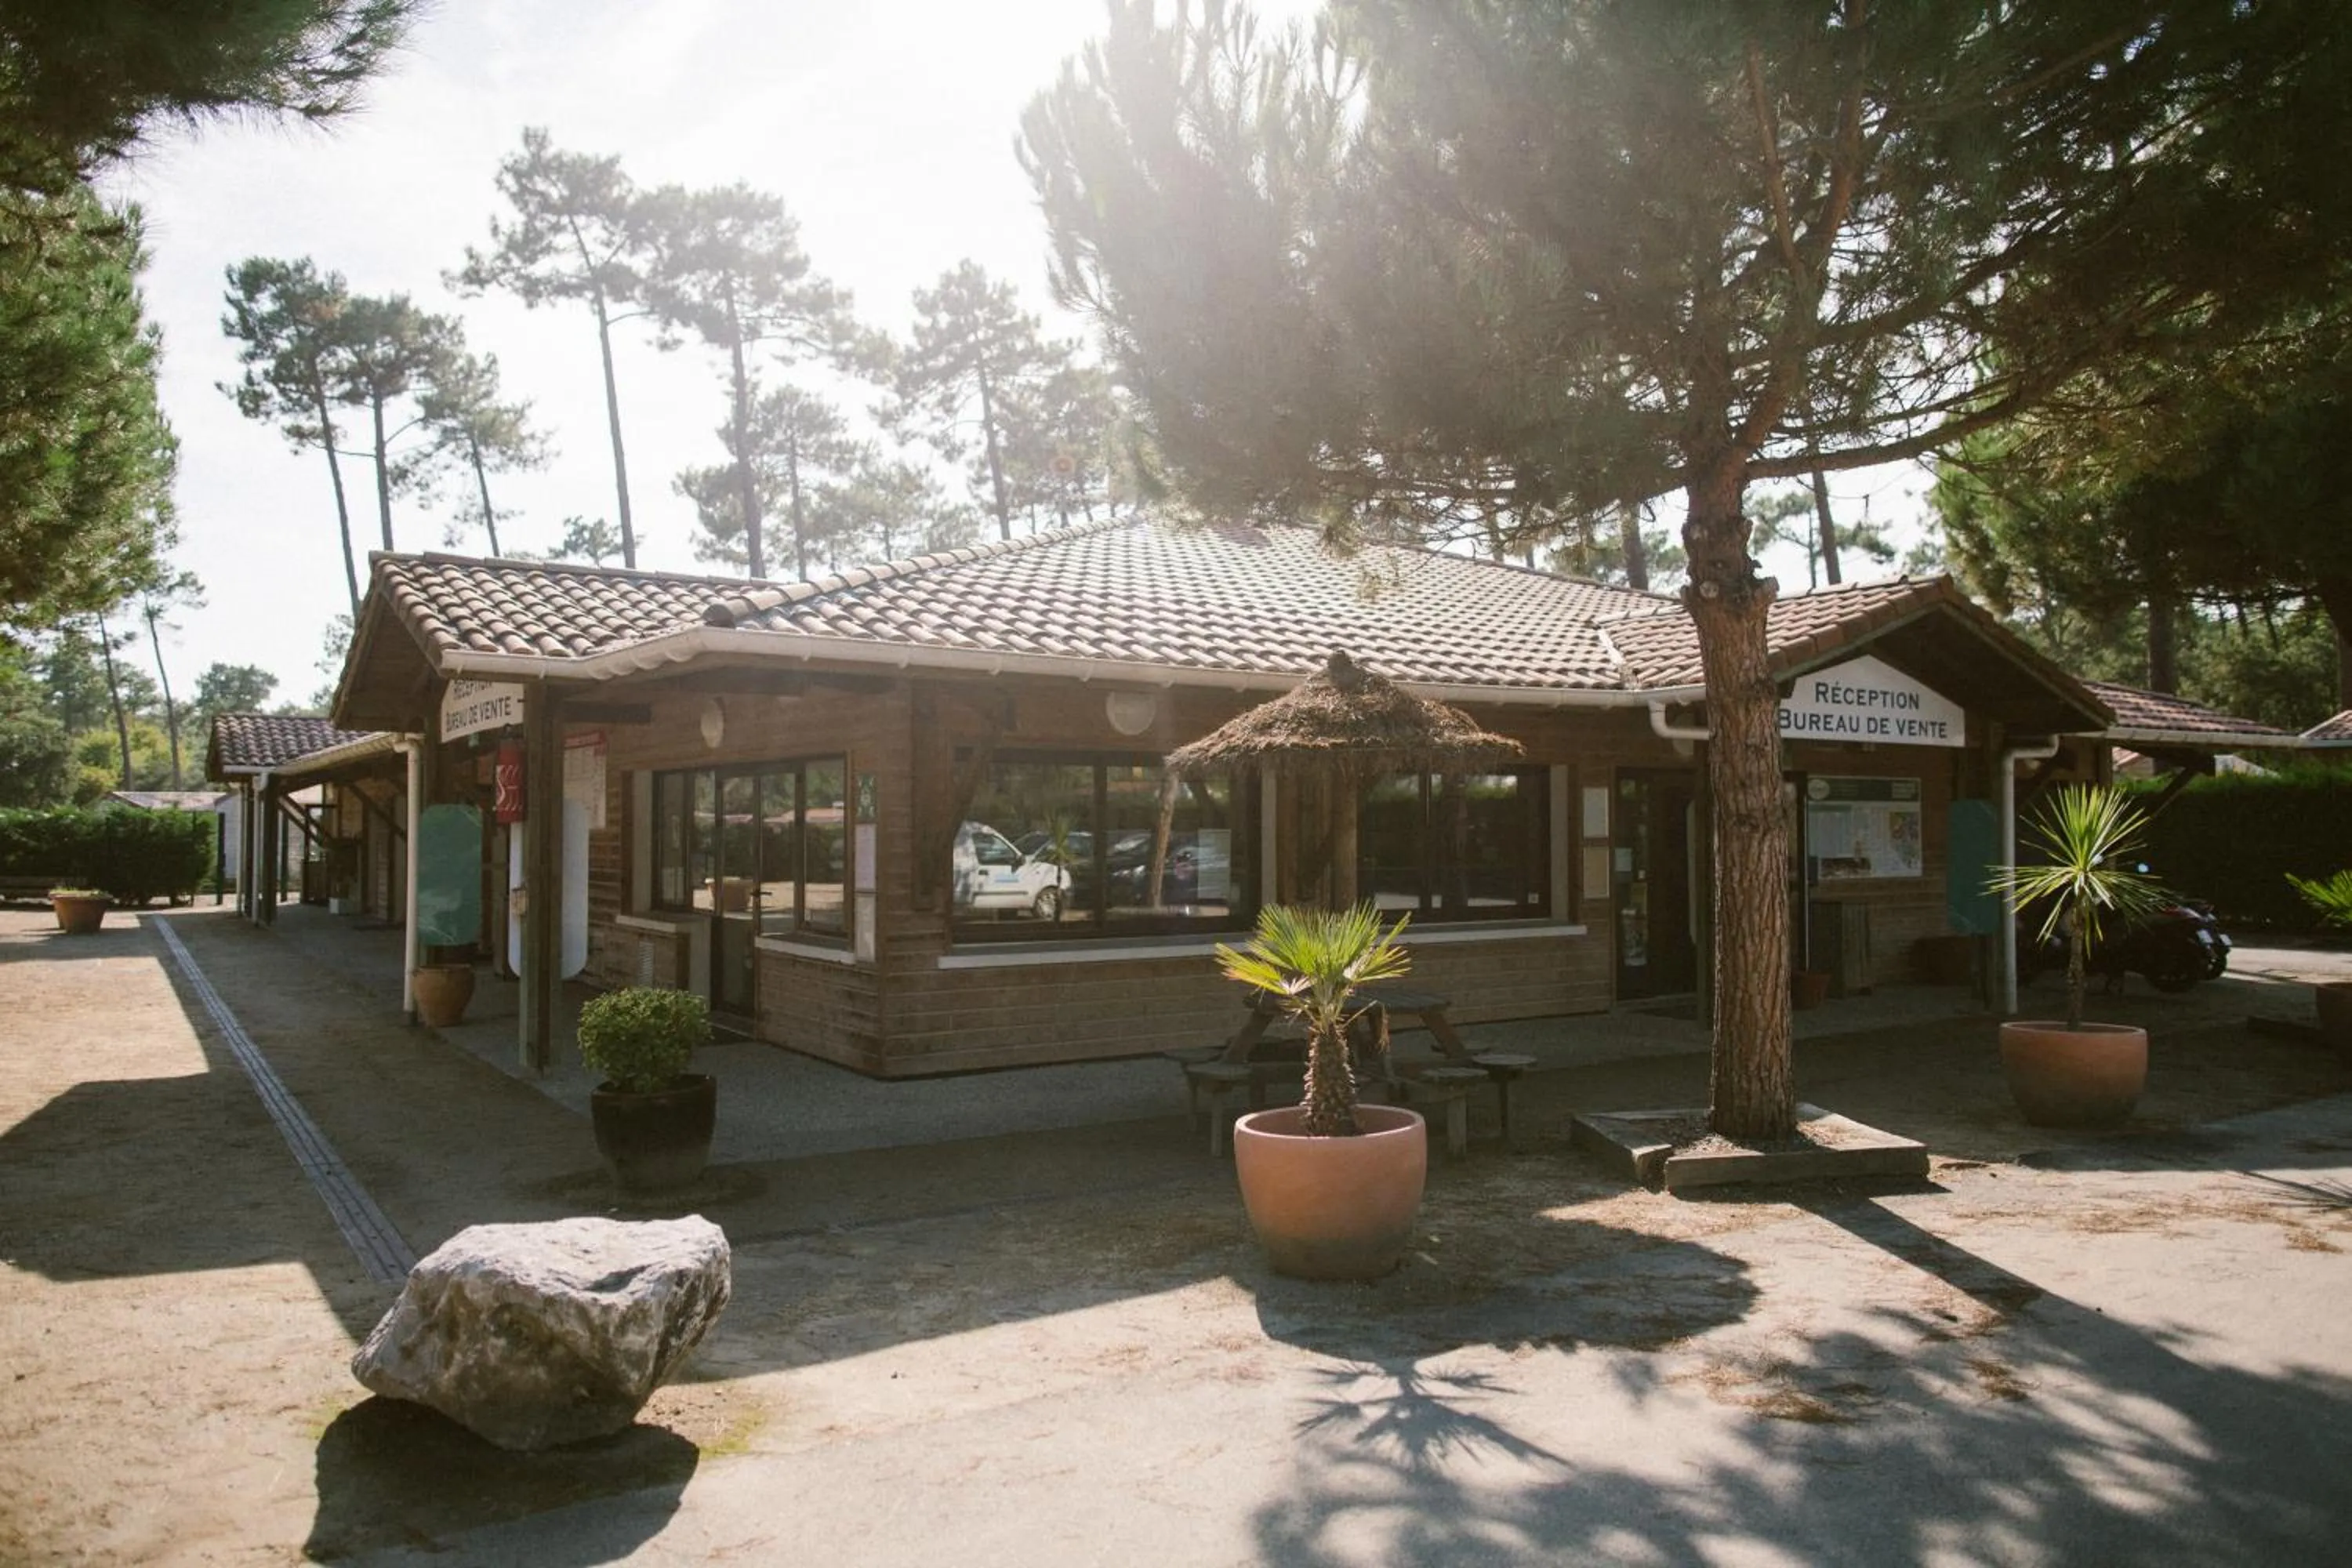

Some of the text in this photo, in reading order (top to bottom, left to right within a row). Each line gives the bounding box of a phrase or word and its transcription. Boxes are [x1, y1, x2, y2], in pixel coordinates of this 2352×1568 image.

[469, 704, 478, 725] DE
[479, 695, 512, 722] VENTE
[1815, 681, 1920, 710] RÉCEPTION
[1778, 709, 1948, 739] BUREAU DE VENTE
